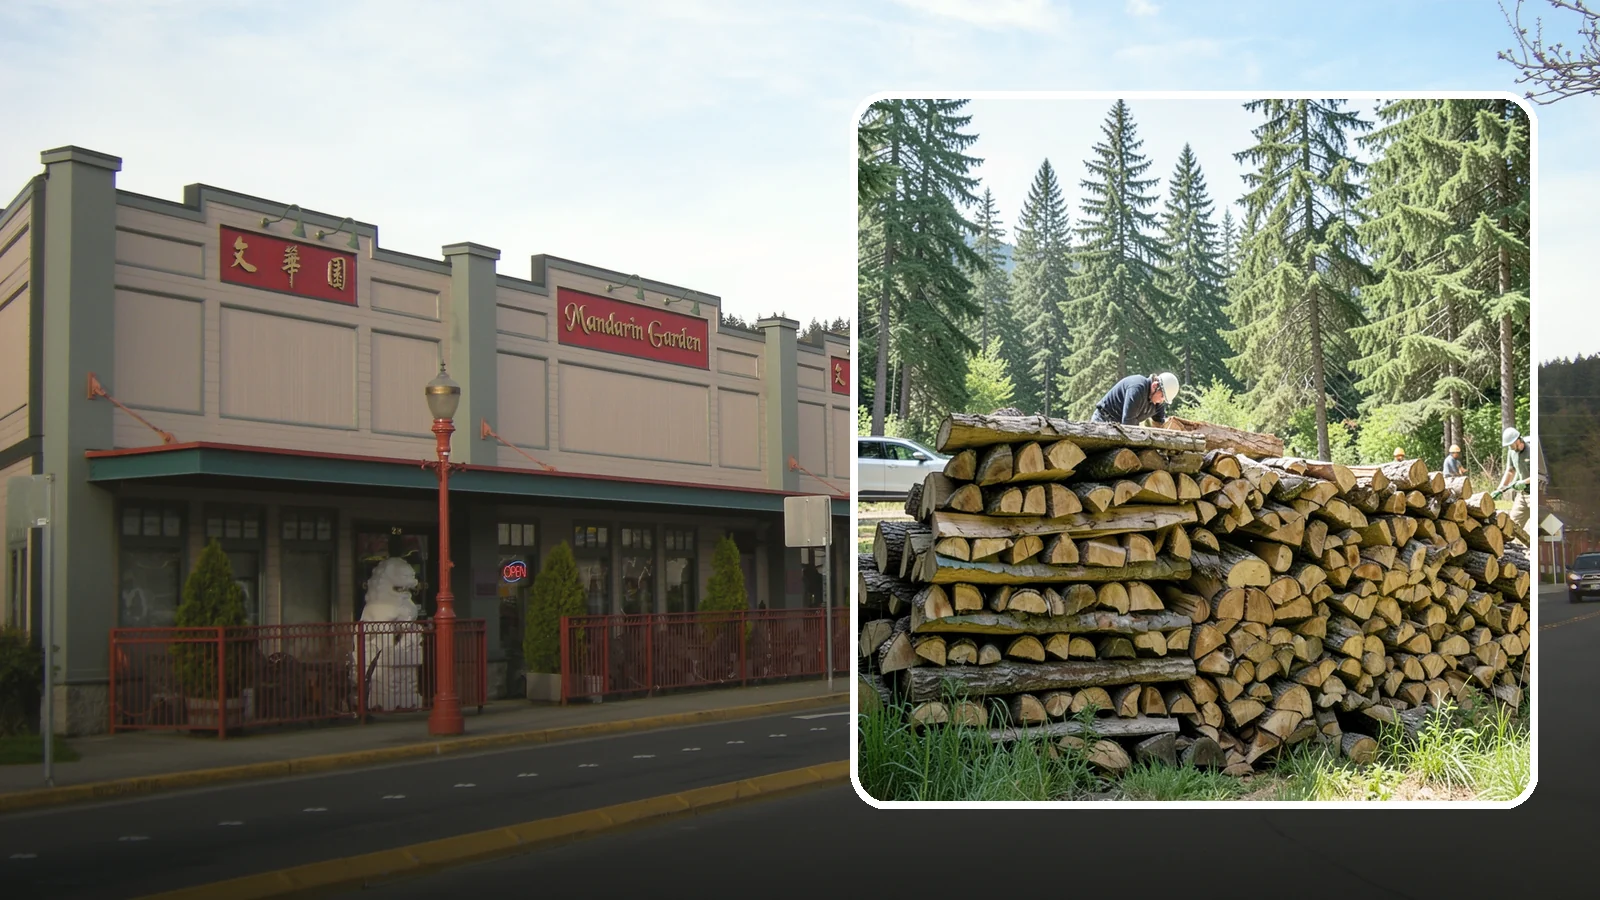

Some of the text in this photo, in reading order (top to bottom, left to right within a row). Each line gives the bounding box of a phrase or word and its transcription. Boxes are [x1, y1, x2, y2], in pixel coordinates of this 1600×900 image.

[230, 235, 346, 291] 文華園
[564, 302, 702, 352] Mandarin Garden
[503, 565, 527, 578] OPEN
